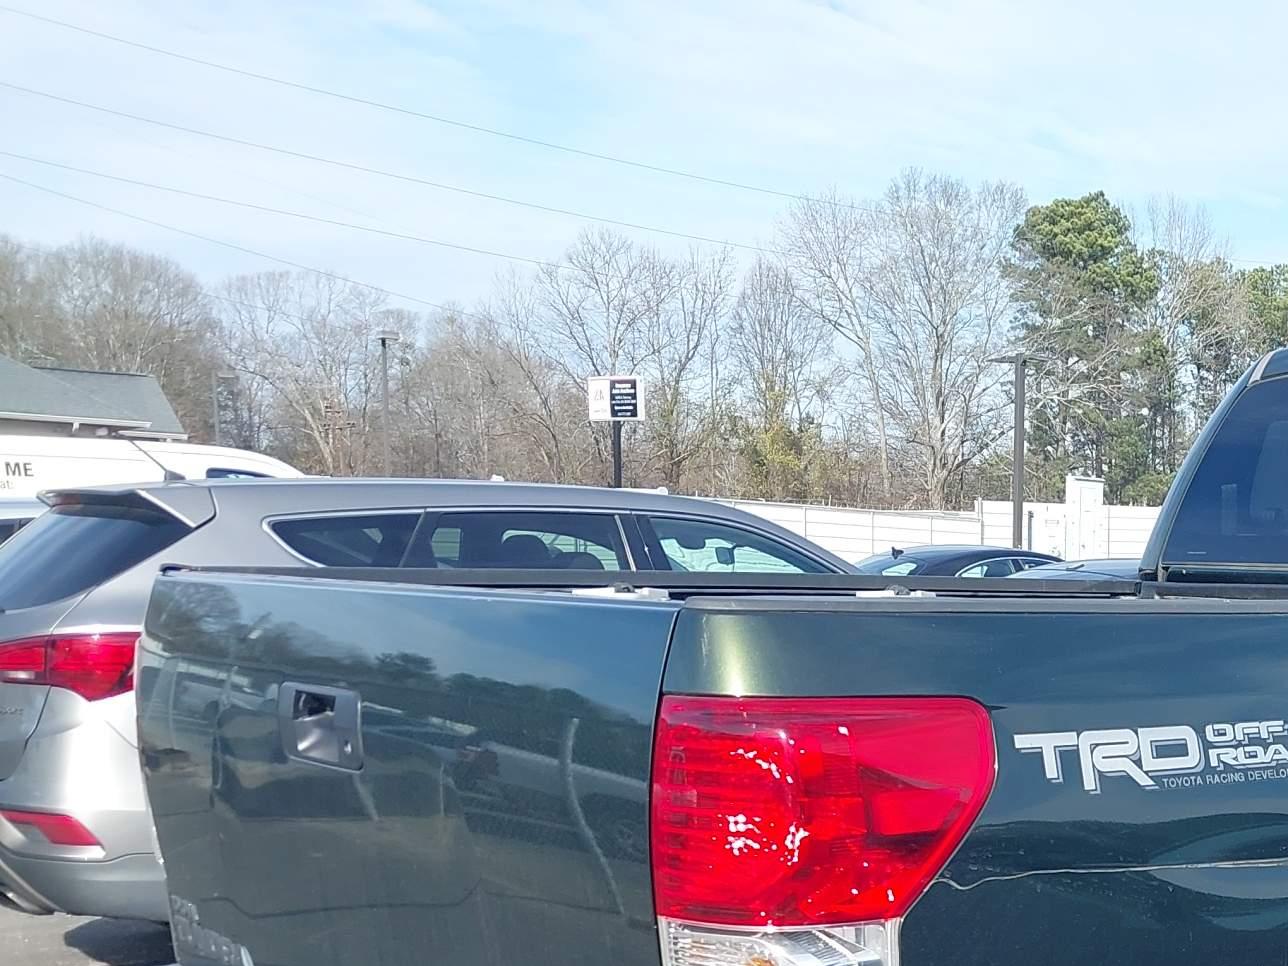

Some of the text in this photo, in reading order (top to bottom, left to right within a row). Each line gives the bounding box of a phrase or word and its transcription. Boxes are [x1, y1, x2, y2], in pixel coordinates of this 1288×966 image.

[4, 461, 34, 477] ME
[1205, 720, 1288, 744] OFF
[1013, 725, 1204, 794] TRD
[1162, 776, 1203, 789] TOYOTA
[1206, 771, 1245, 784] RACING
